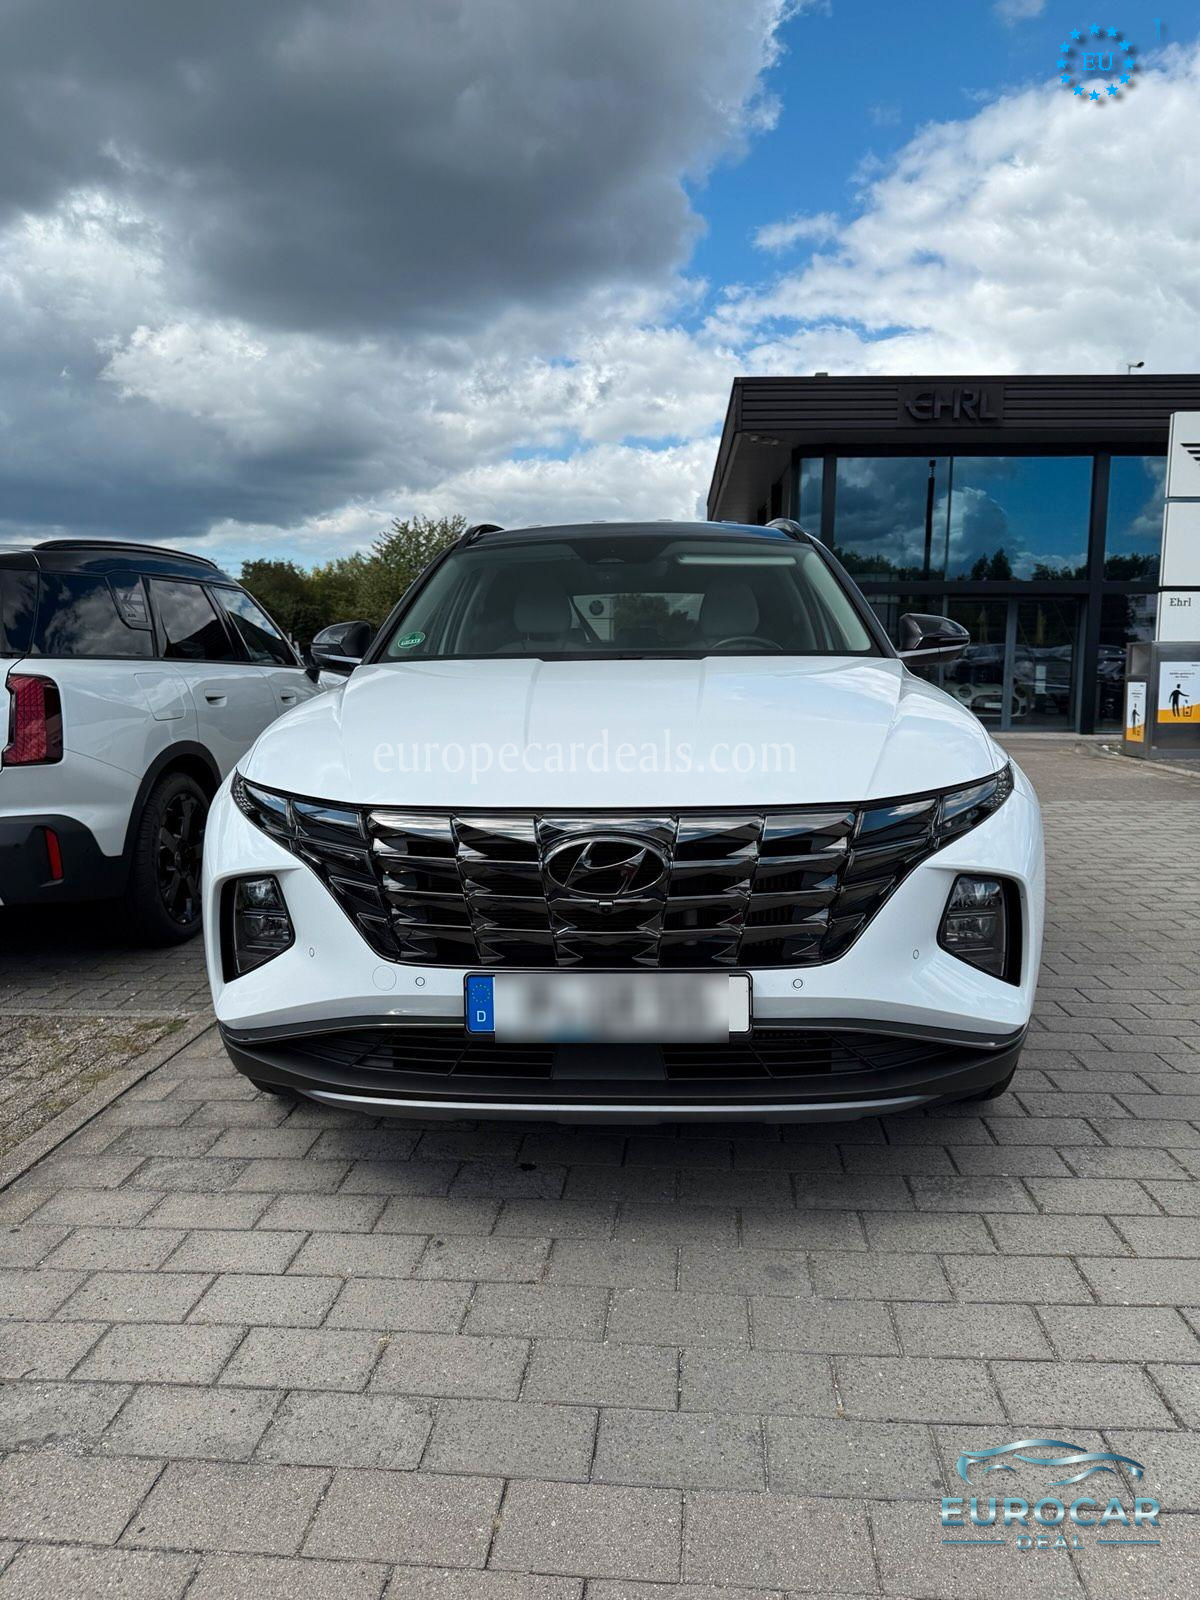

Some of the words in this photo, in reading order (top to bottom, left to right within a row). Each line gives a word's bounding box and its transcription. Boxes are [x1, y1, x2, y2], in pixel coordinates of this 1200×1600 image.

[905, 388, 999, 420] EHRL
[1169, 597, 1192, 607] Ehrl
[476, 1010, 486, 1022] D
